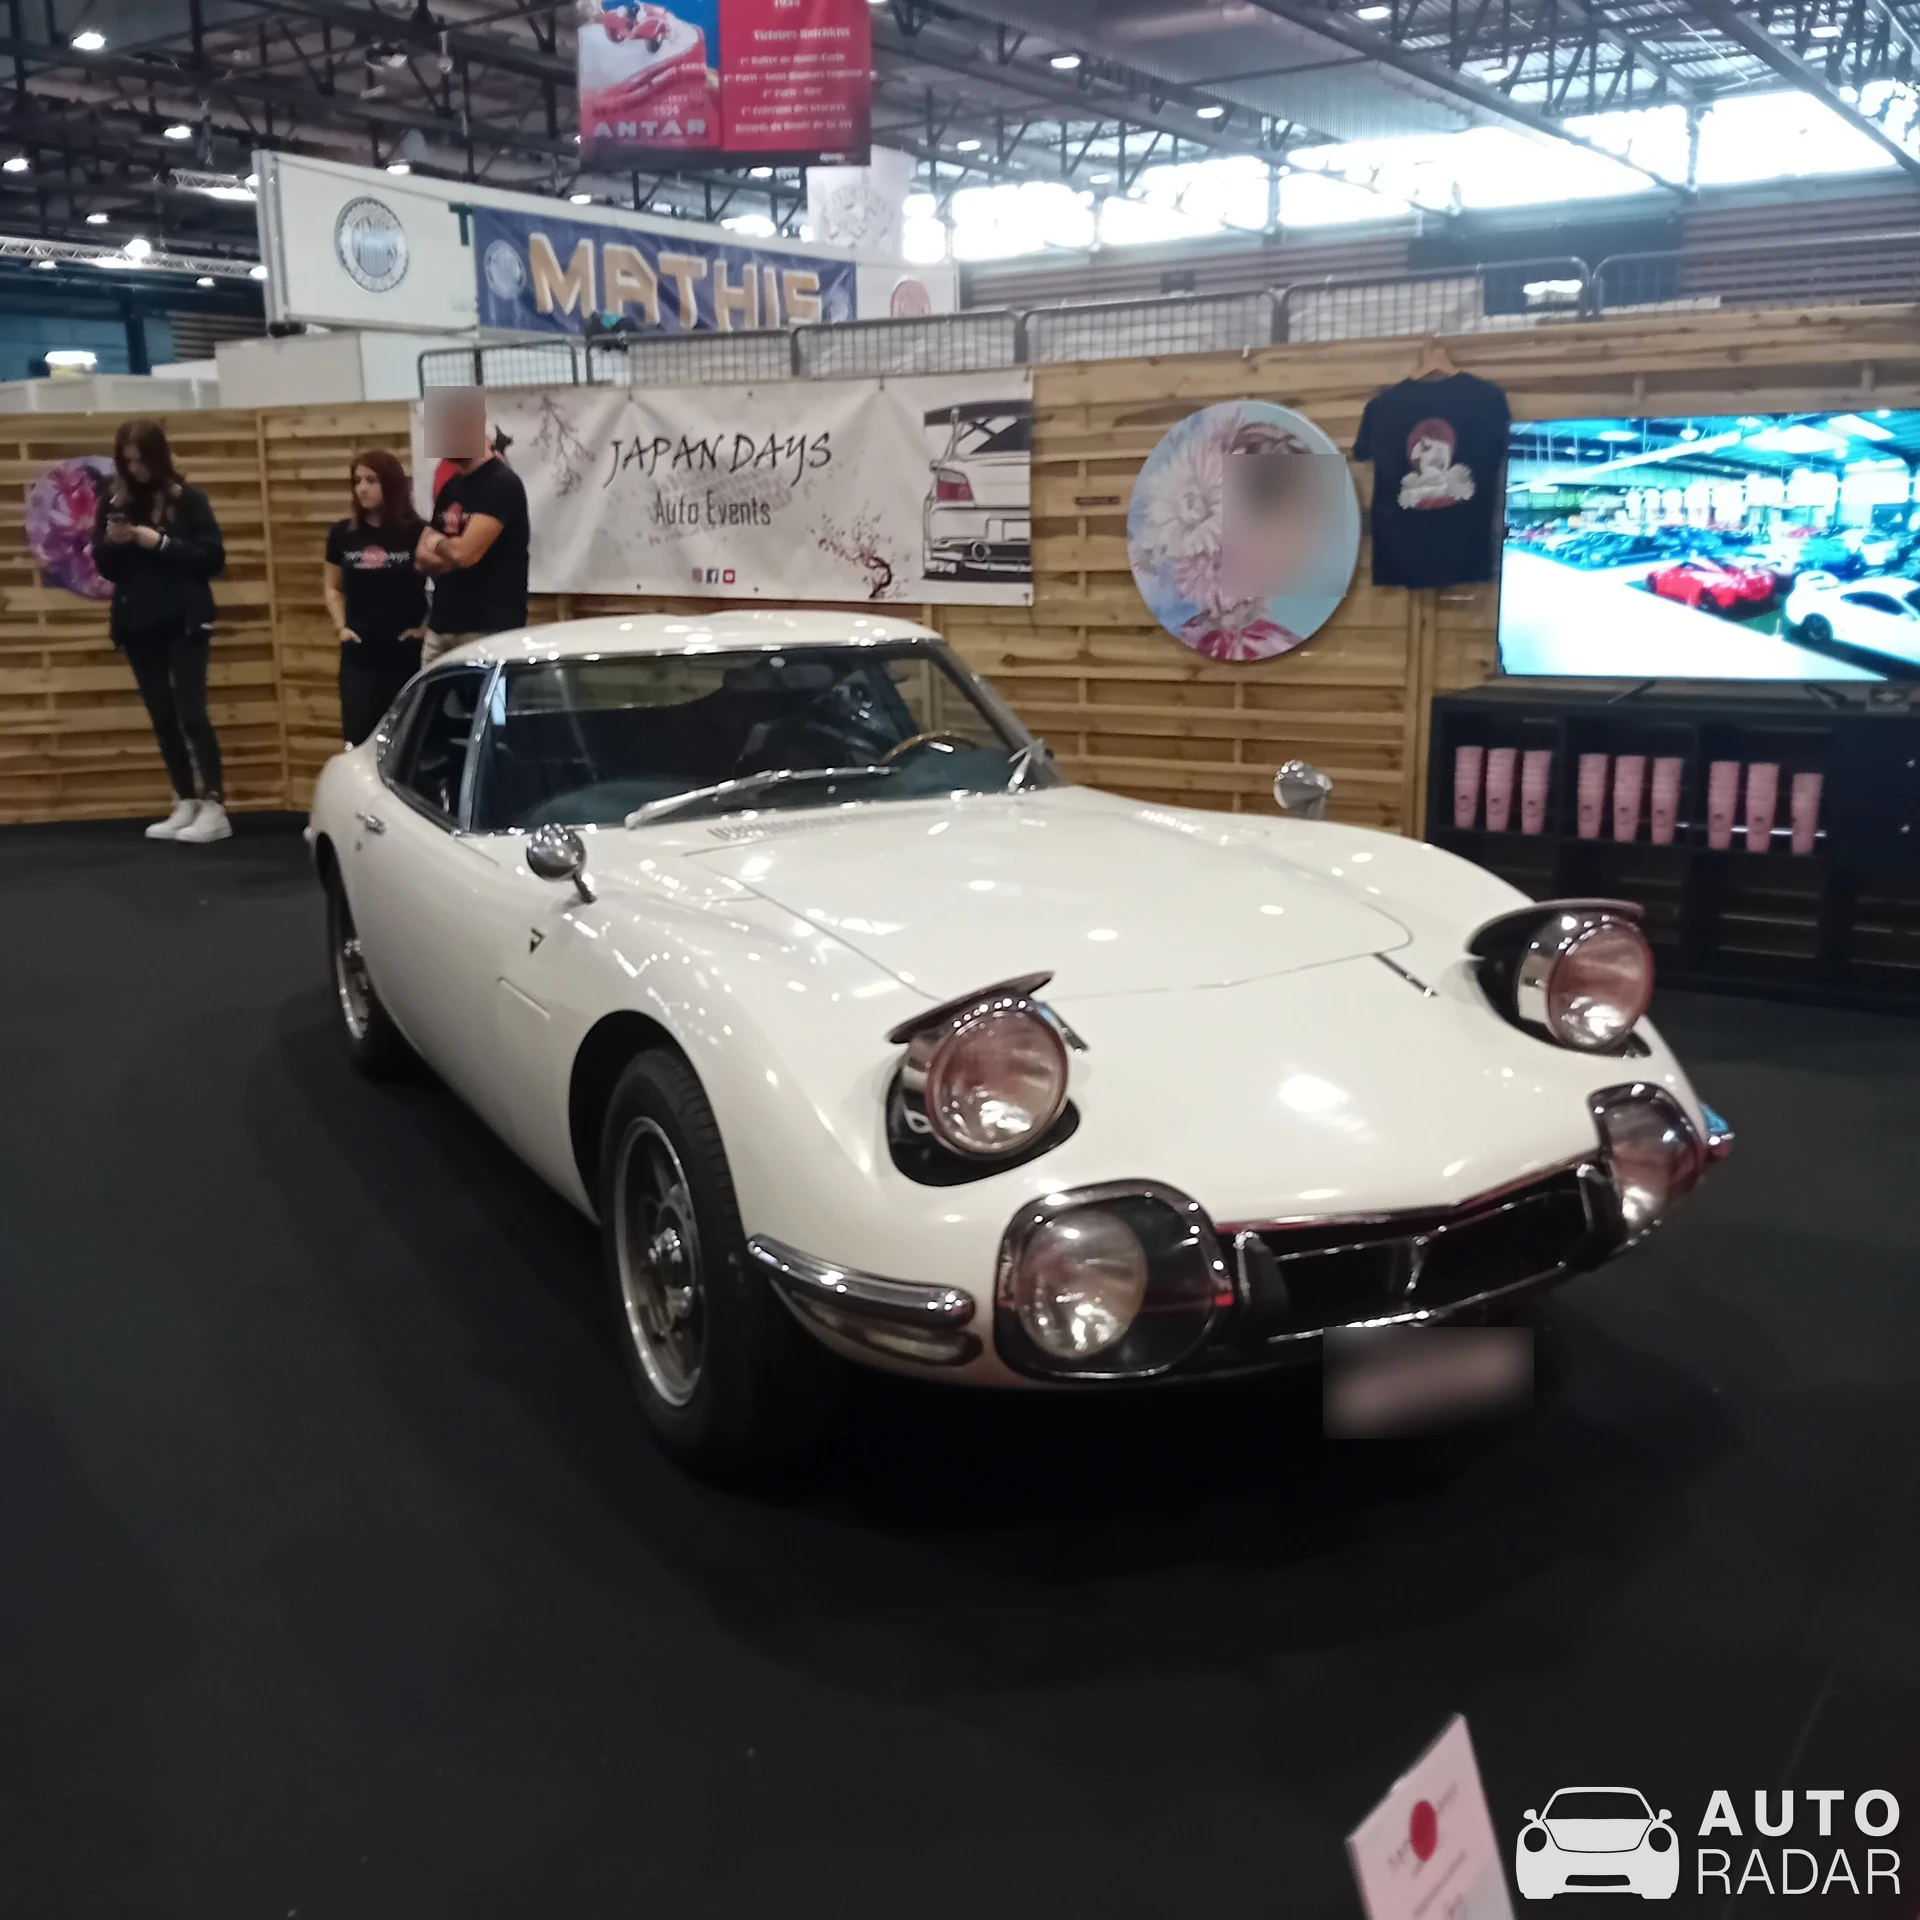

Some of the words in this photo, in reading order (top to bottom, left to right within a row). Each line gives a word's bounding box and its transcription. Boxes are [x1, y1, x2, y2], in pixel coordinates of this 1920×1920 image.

[594, 118, 706, 138] ANTAR
[529, 232, 823, 333] MATHIS
[603, 434, 724, 489] JAPAN
[729, 431, 832, 488] DAYS
[655, 491, 699, 526] Auto
[706, 489, 771, 526] Events
